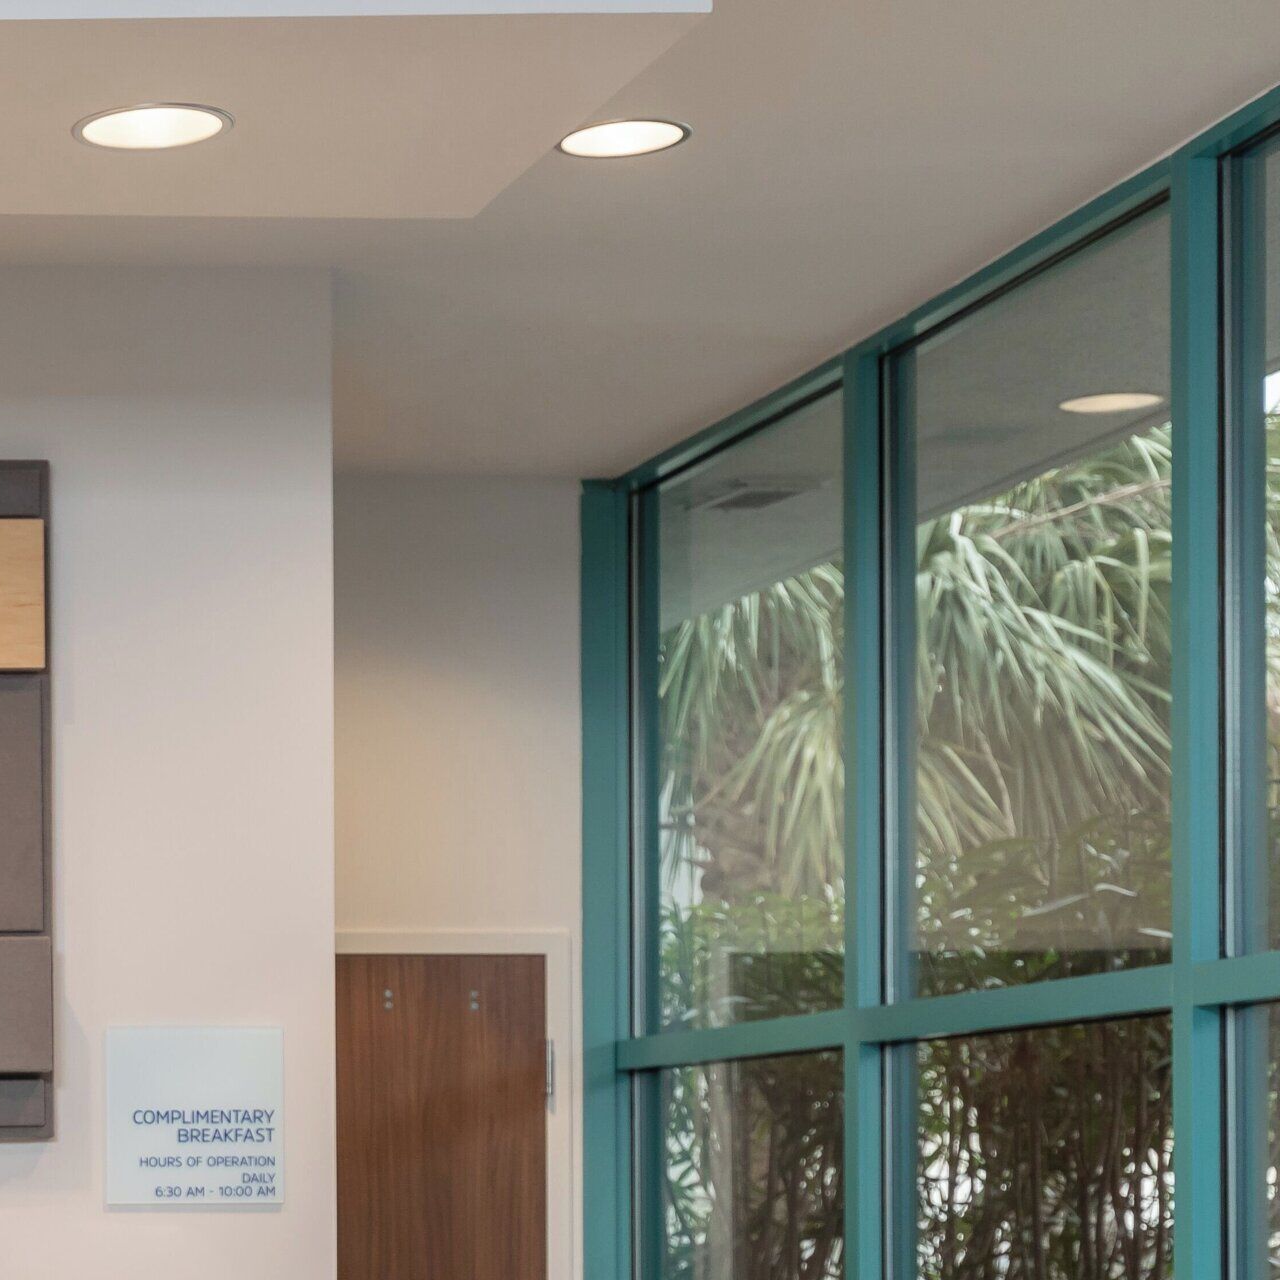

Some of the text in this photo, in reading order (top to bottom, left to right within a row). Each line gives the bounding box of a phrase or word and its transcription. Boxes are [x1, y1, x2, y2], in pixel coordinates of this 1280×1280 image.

[132, 1109, 275, 1125] COMPLIMENTARY
[177, 1128, 275, 1143] BREAKFAST
[139, 1156, 276, 1168] HOURS OF OPERATION
[242, 1172, 276, 1184] DAILY
[155, 1186, 182, 1198] 6:30
[186, 1186, 205, 1197] AM
[219, 1186, 253, 1197] 10:00
[257, 1186, 276, 1197] AM
